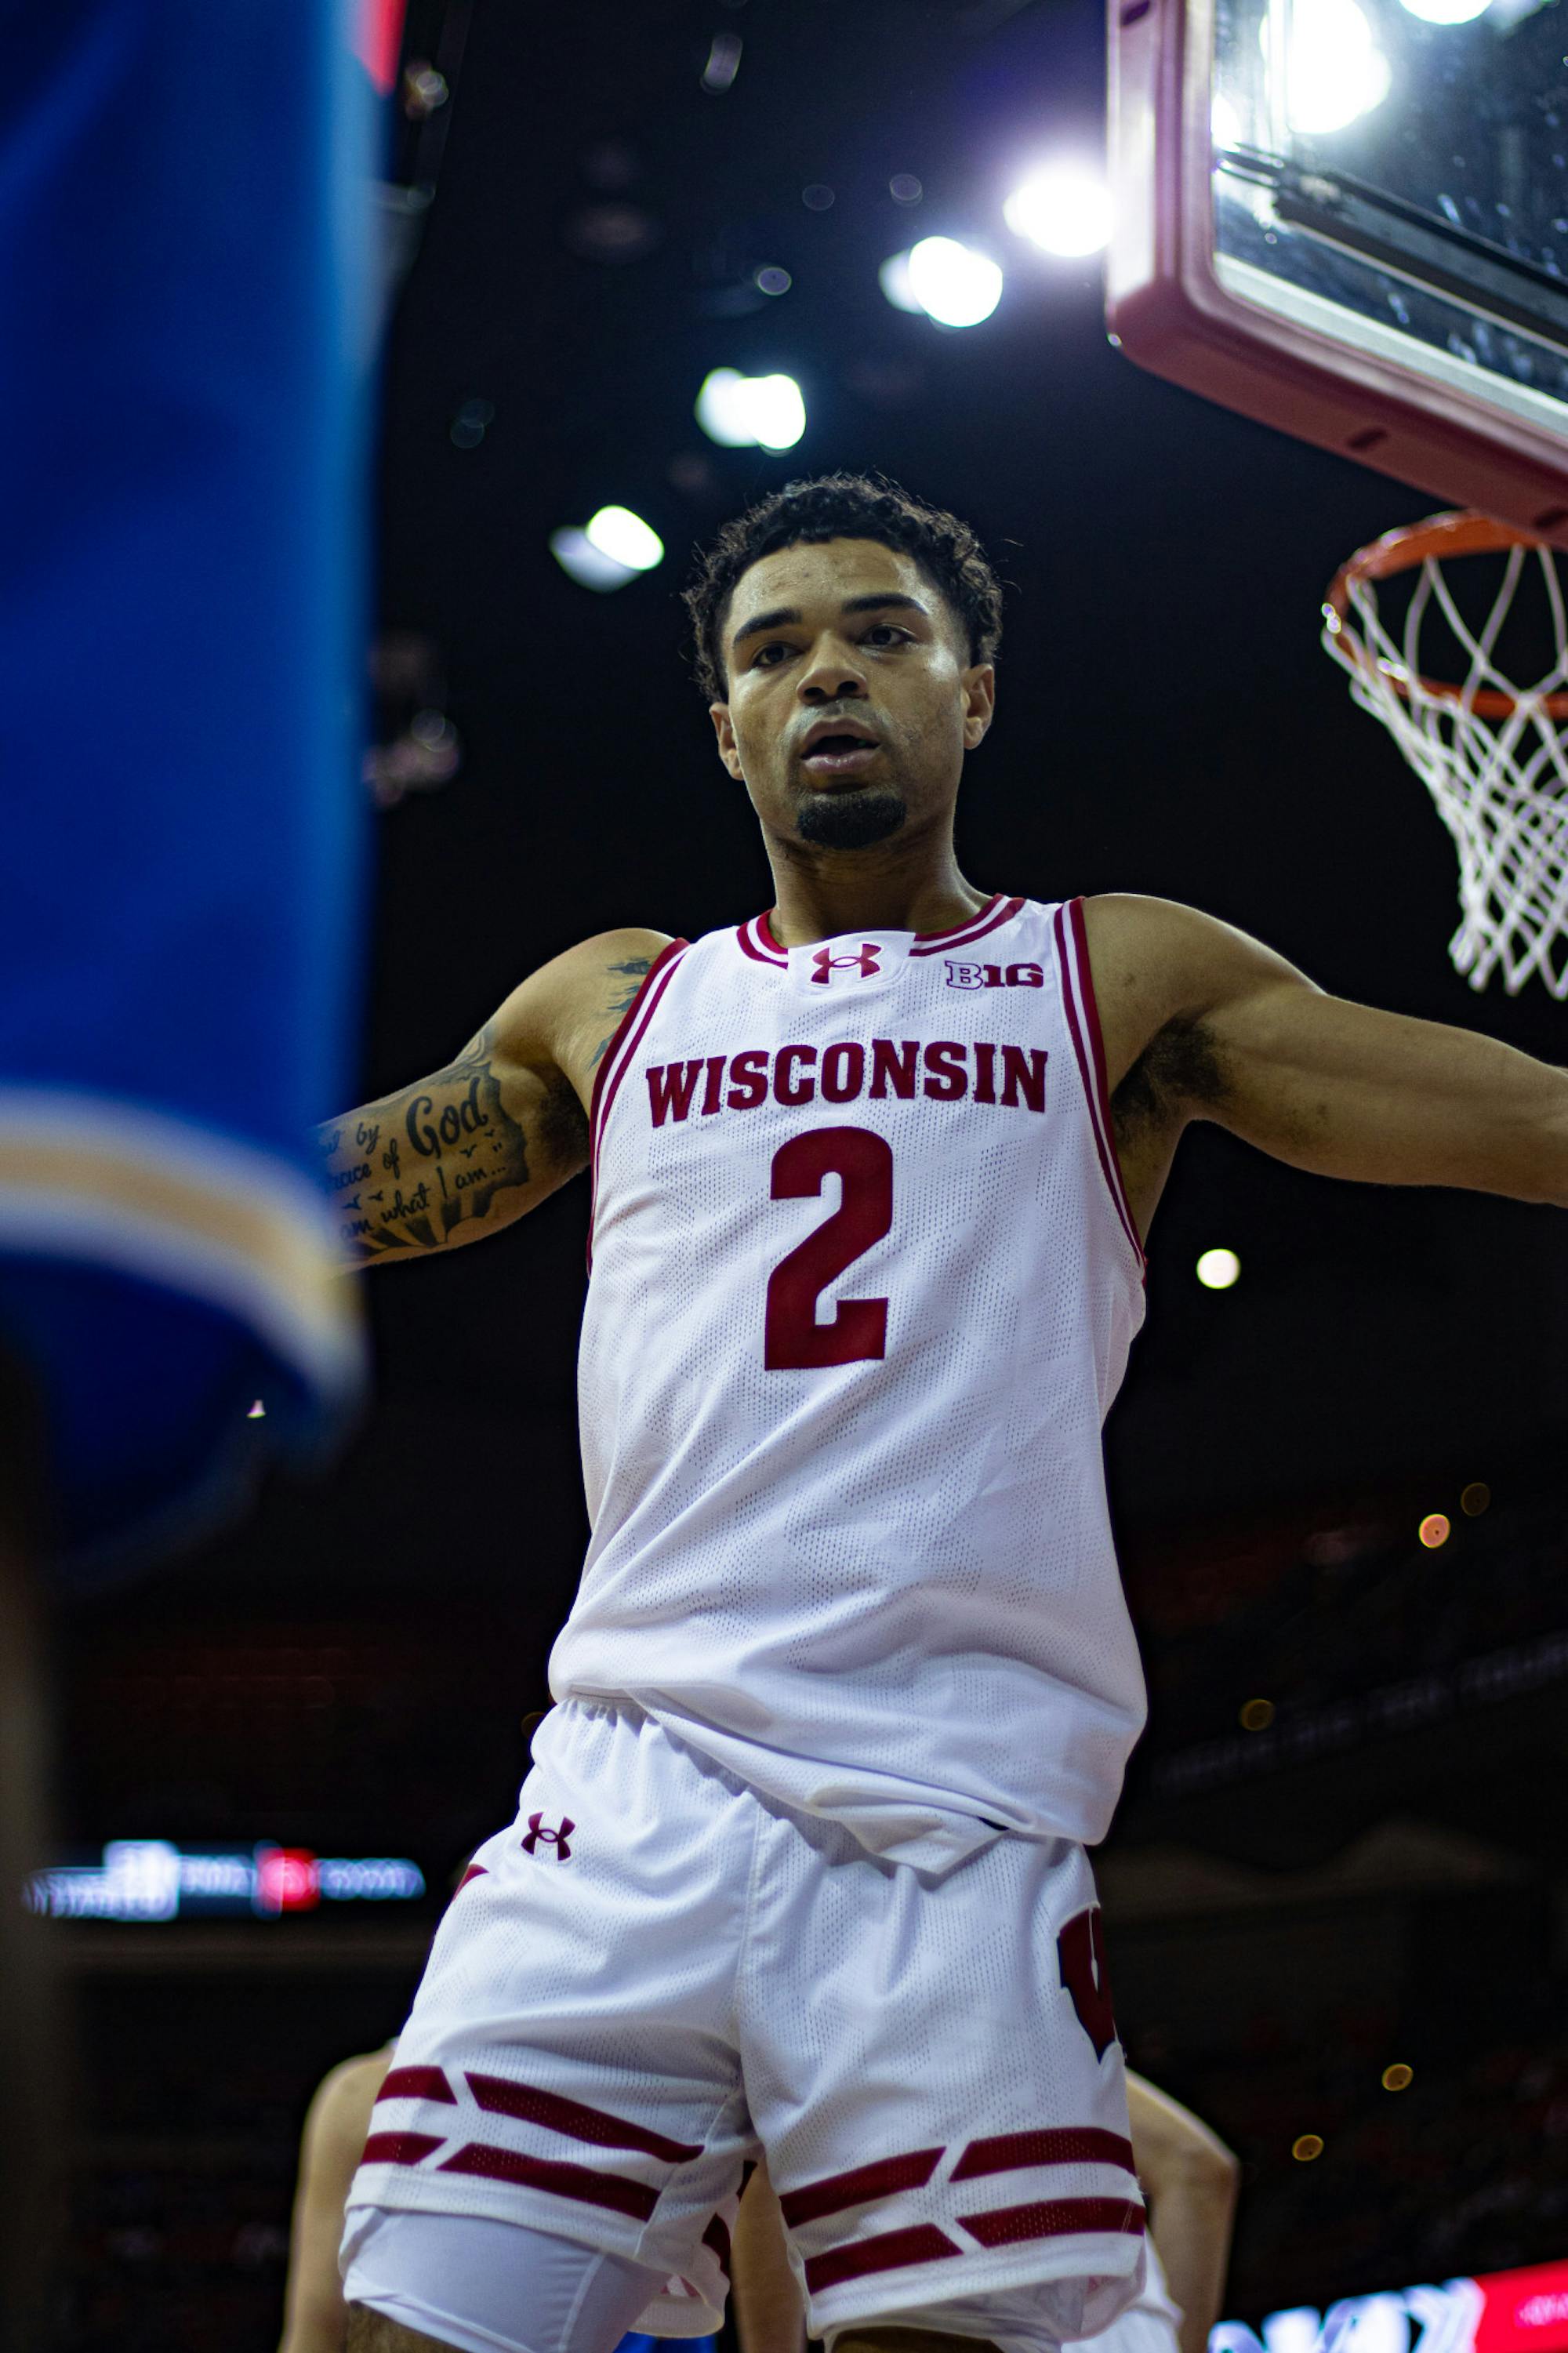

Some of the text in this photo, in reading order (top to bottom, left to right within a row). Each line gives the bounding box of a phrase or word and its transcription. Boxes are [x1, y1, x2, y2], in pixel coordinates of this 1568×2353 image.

[383, 1138, 401, 1179] of
[405, 1076, 489, 1160] God
[645, 1038, 1048, 1128] WISCONSIN
[357, 1122, 379, 1155] by
[381, 1182, 430, 1223] what
[764, 1126, 893, 1371] 2
